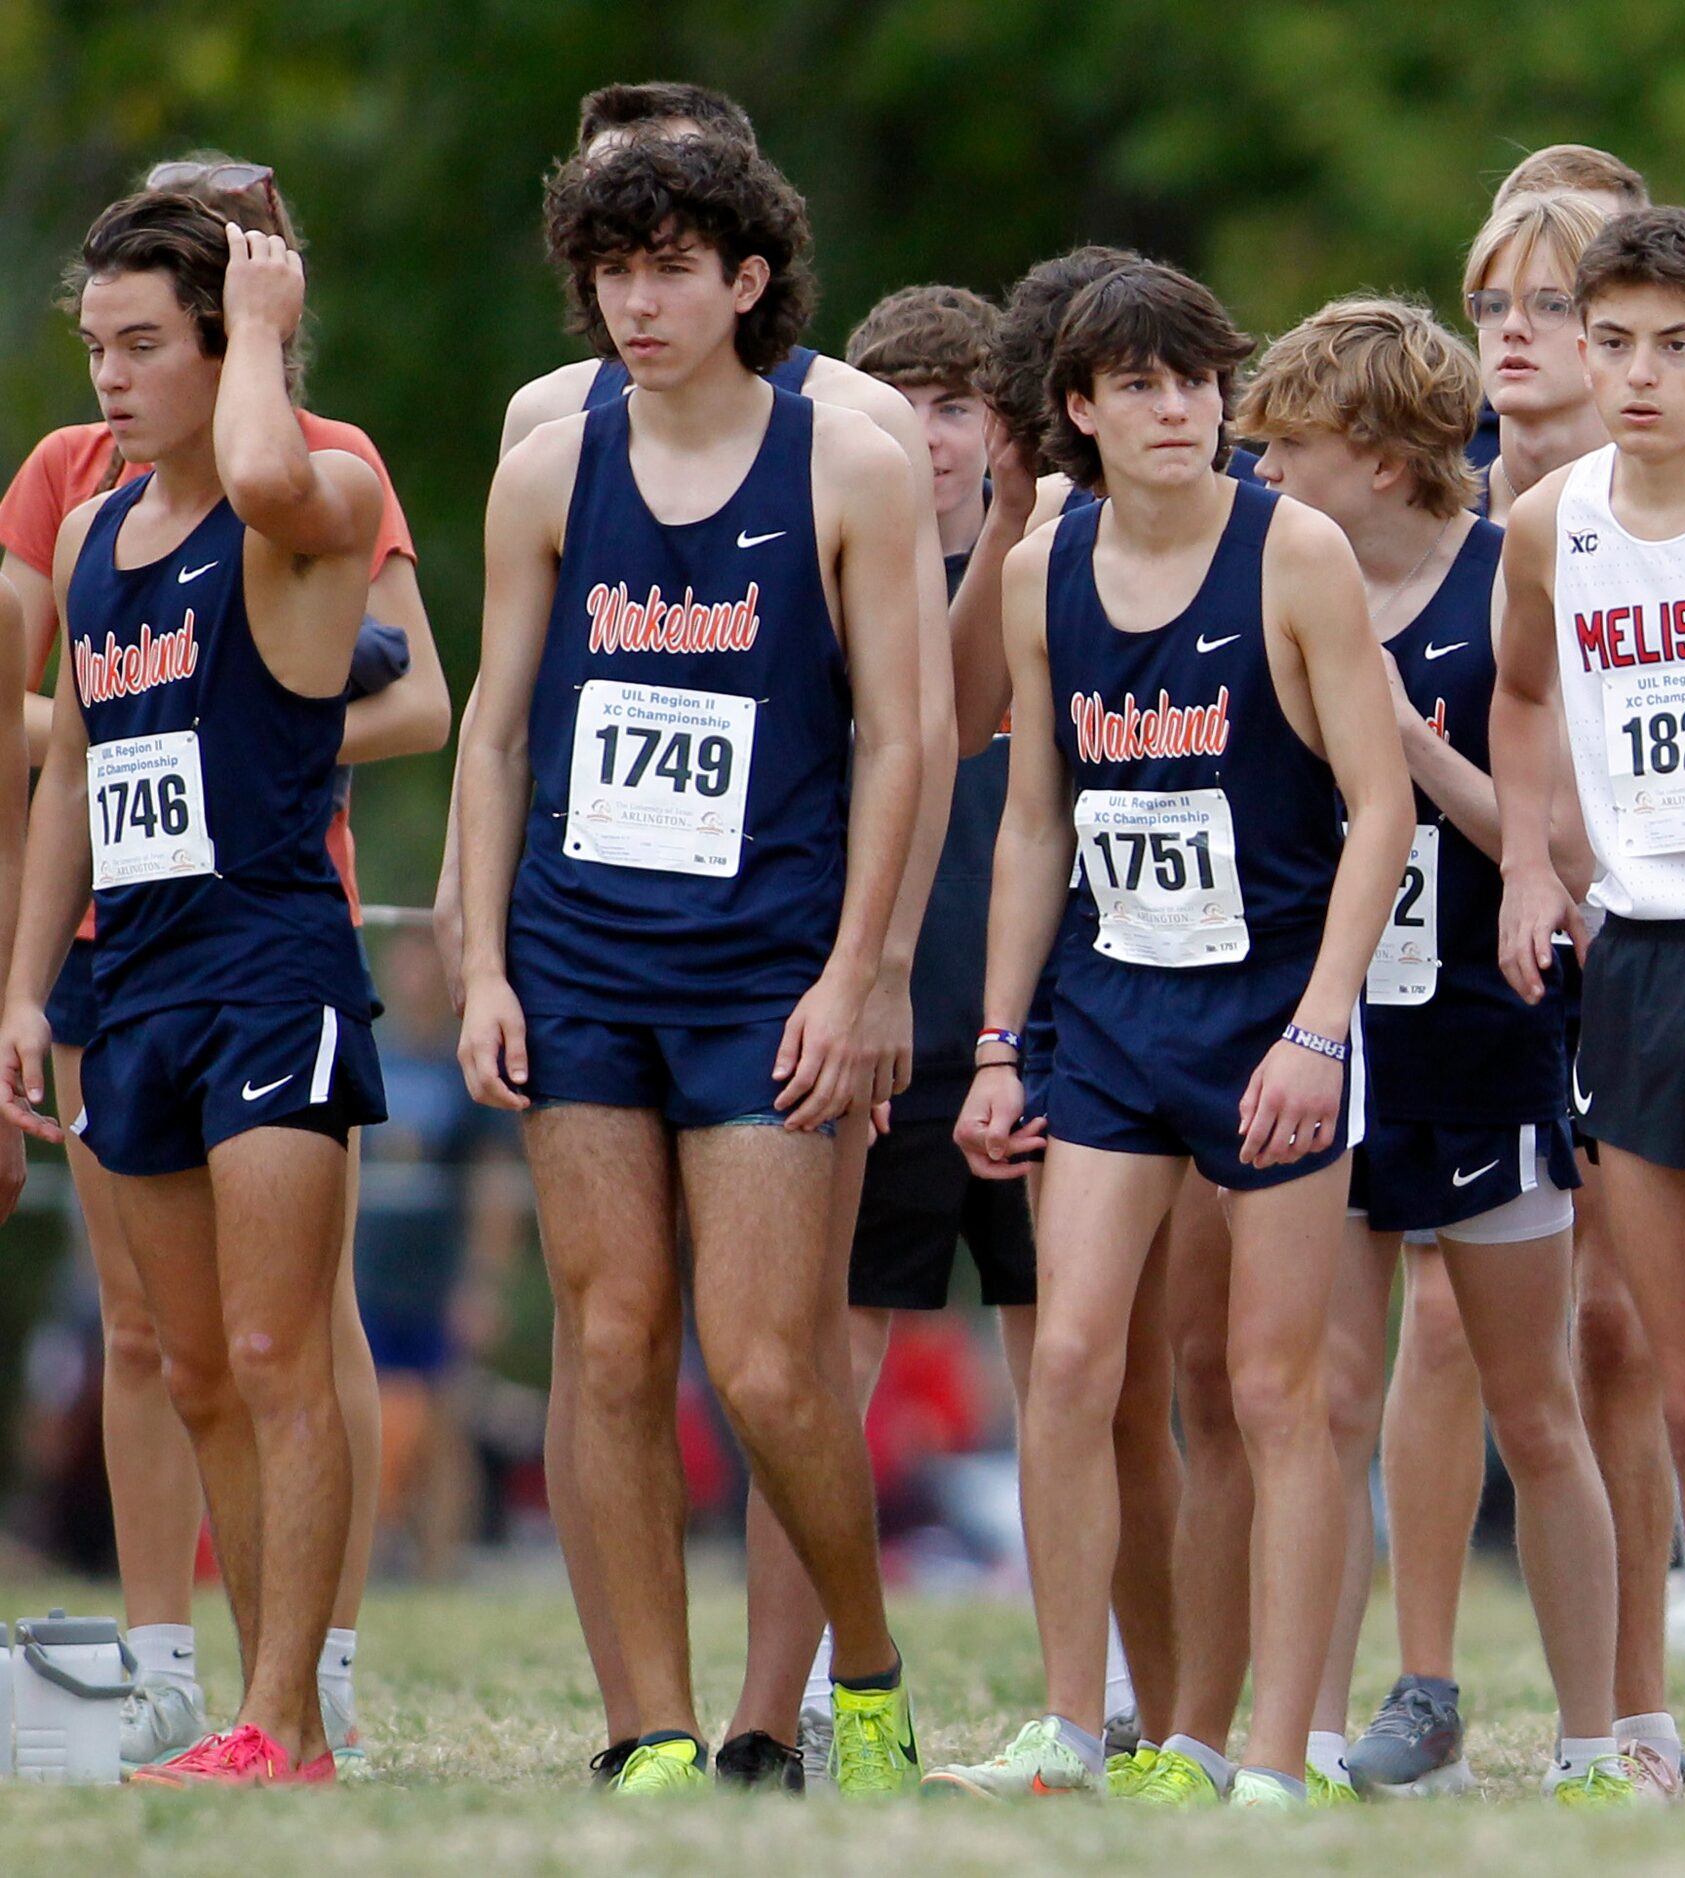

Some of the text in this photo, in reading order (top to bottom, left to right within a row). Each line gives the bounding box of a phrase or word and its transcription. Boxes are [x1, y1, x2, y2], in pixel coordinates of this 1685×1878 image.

[586, 580, 760, 655] Wakeland
[74, 607, 199, 709] Wakeland
[1637, 677, 1659, 690] UIL
[622, 689, 645, 702] UIL
[650, 692, 700, 709] Region
[1626, 697, 1643, 708] XC
[603, 704, 731, 730] XC Championship
[1071, 685, 1230, 765] Wakeland
[116, 743, 152, 757] Region
[106, 755, 178, 775] Championship
[596, 724, 733, 798] 1749
[97, 773, 189, 846] 1746
[1109, 796, 1128, 807] UIL
[1131, 796, 1176, 810] Region
[620, 811, 687, 827] ARLINGTON
[1094, 811, 1210, 825] XC Championship
[1093, 831, 1215, 891] 1751
